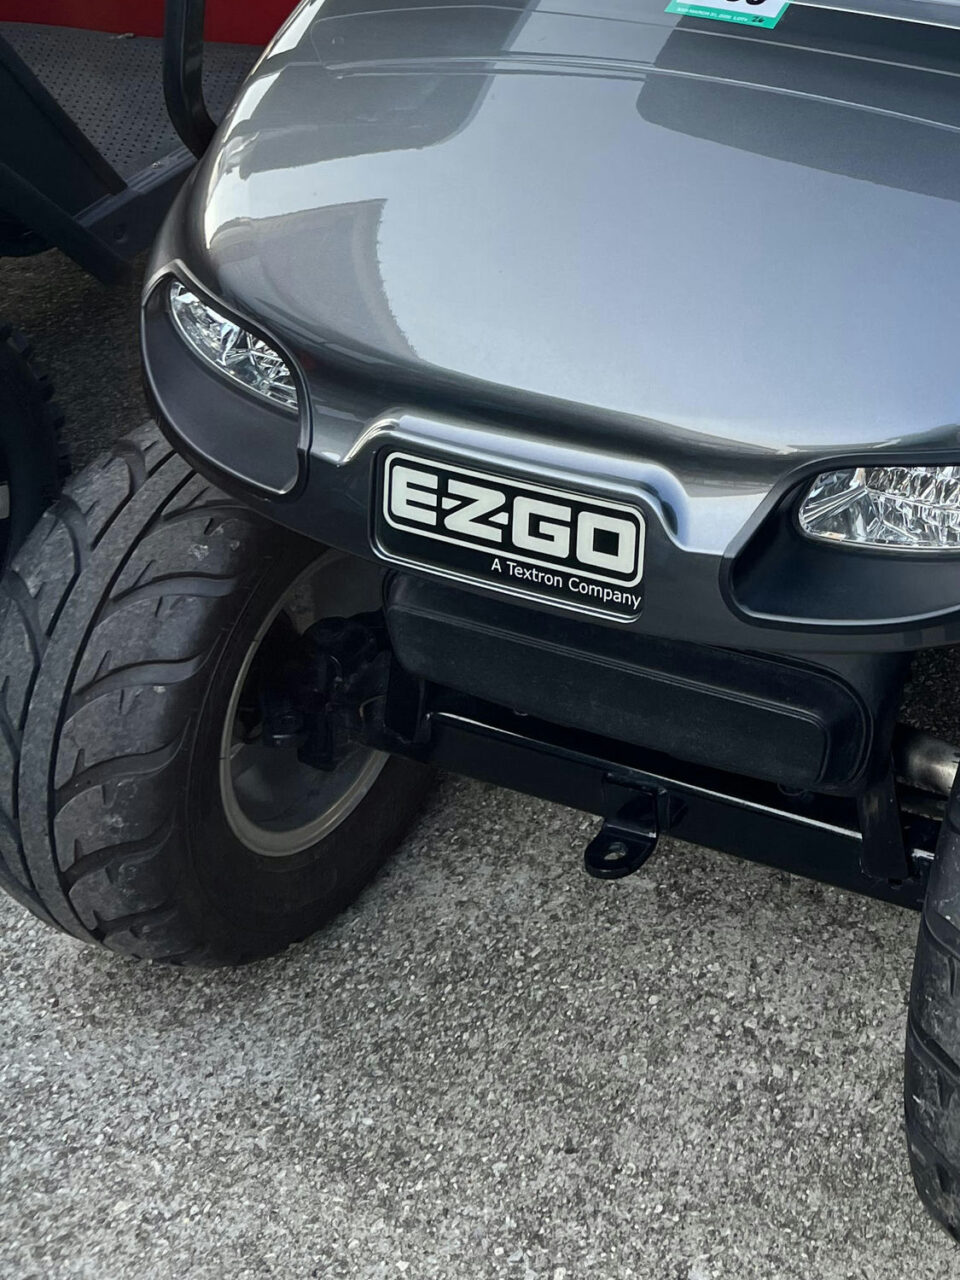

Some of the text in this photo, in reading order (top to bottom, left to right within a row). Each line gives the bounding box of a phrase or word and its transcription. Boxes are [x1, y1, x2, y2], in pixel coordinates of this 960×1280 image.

[391, 465, 637, 574] EZGO
[491, 558, 642, 610] A Textron Company
